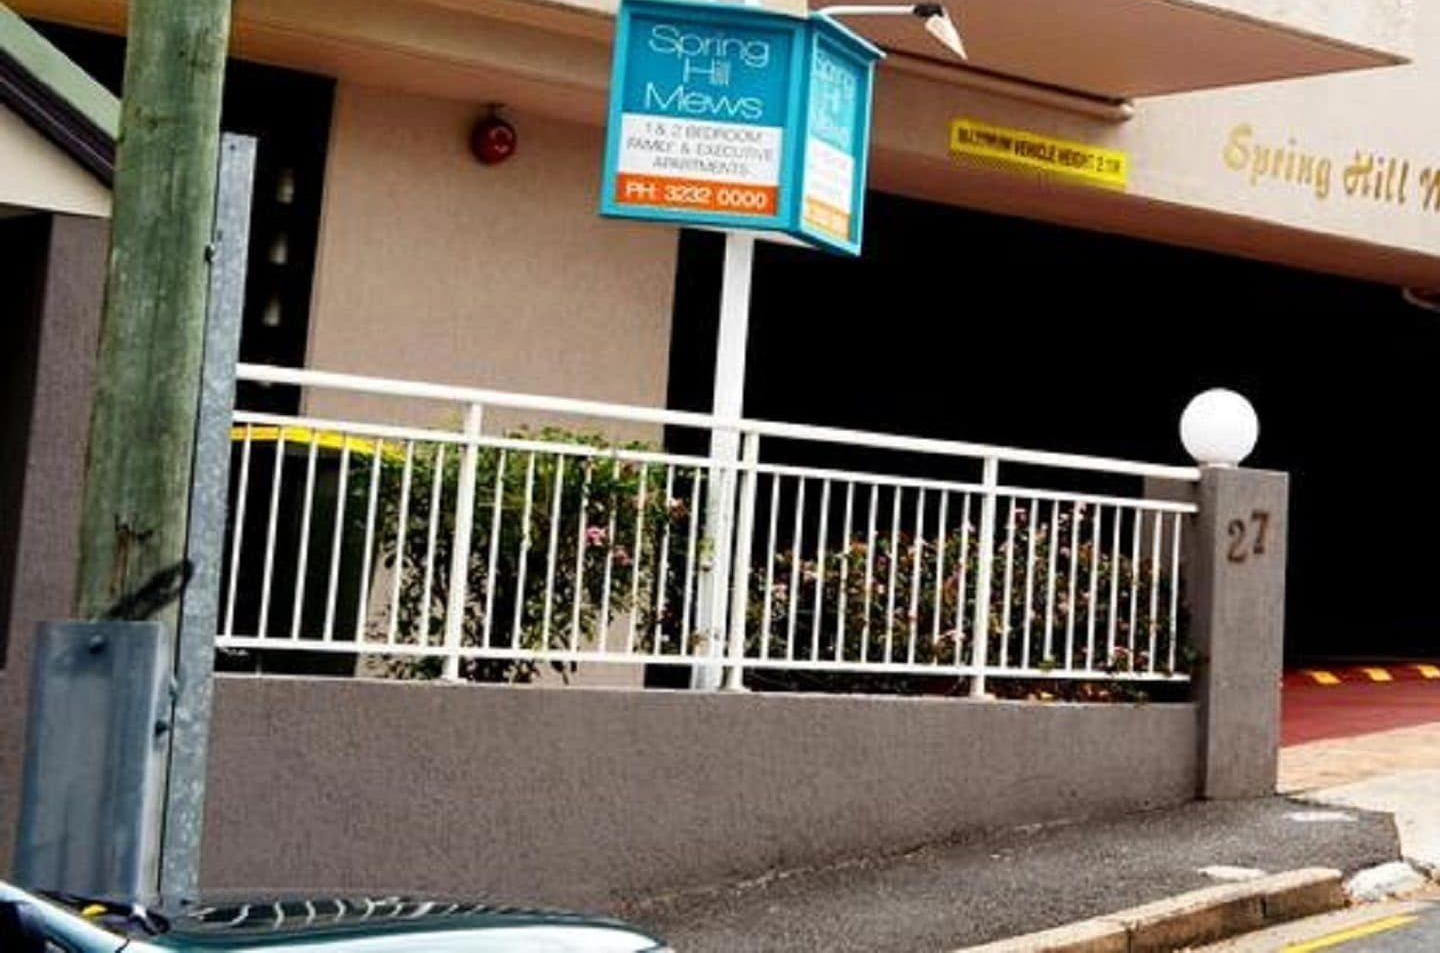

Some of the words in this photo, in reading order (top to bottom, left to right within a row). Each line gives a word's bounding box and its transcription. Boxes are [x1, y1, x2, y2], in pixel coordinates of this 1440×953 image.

[648, 24, 769, 68] Spring
[683, 57, 731, 87] Hill
[644, 81, 763, 120] Mews
[654, 125, 666, 136] &
[671, 124, 682, 138] 2
[685, 126, 763, 144] BEDROOM
[626, 138, 675, 152] FAMILY
[696, 145, 774, 163] EXECUTIVE
[1014, 140, 1056, 163] VEHICLE
[1222, 123, 1332, 201] Spring
[1342, 150, 1410, 204] Hill
[652, 155, 749, 177] APARTMENTS
[664, 185, 712, 205] 3232
[717, 189, 768, 210] 0000
[1227, 510, 1270, 564] 27
